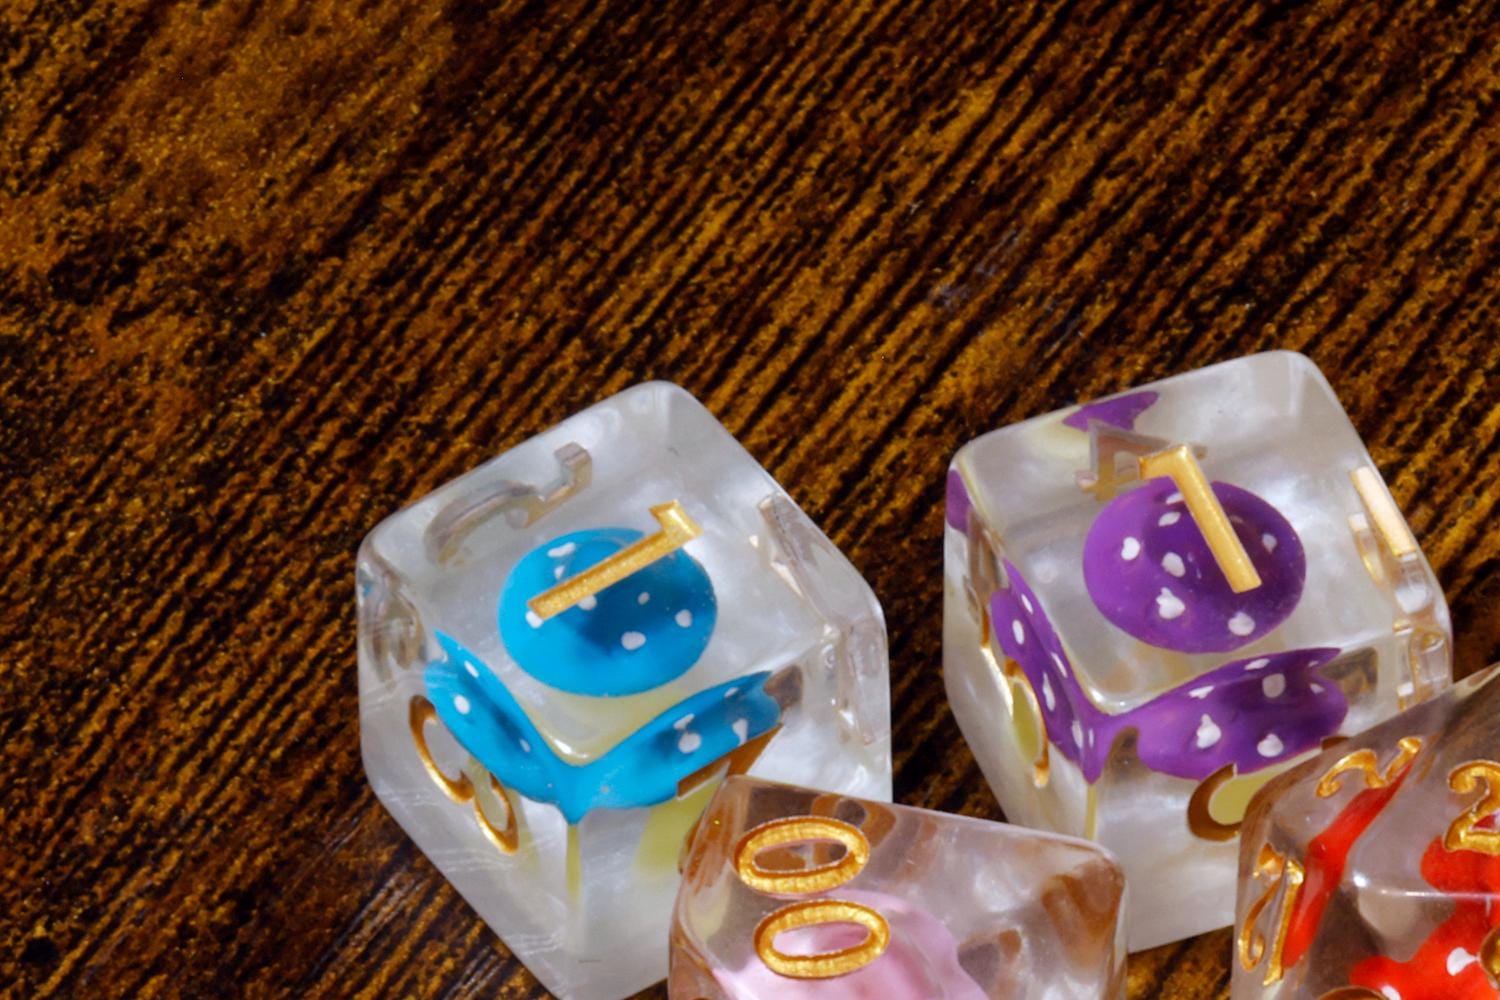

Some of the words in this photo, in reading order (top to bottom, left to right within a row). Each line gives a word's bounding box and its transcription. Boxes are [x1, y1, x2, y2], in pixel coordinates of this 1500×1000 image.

[528, 498, 700, 618] 1
[1138, 443, 1262, 594] 1
[408, 694, 520, 856] 3
